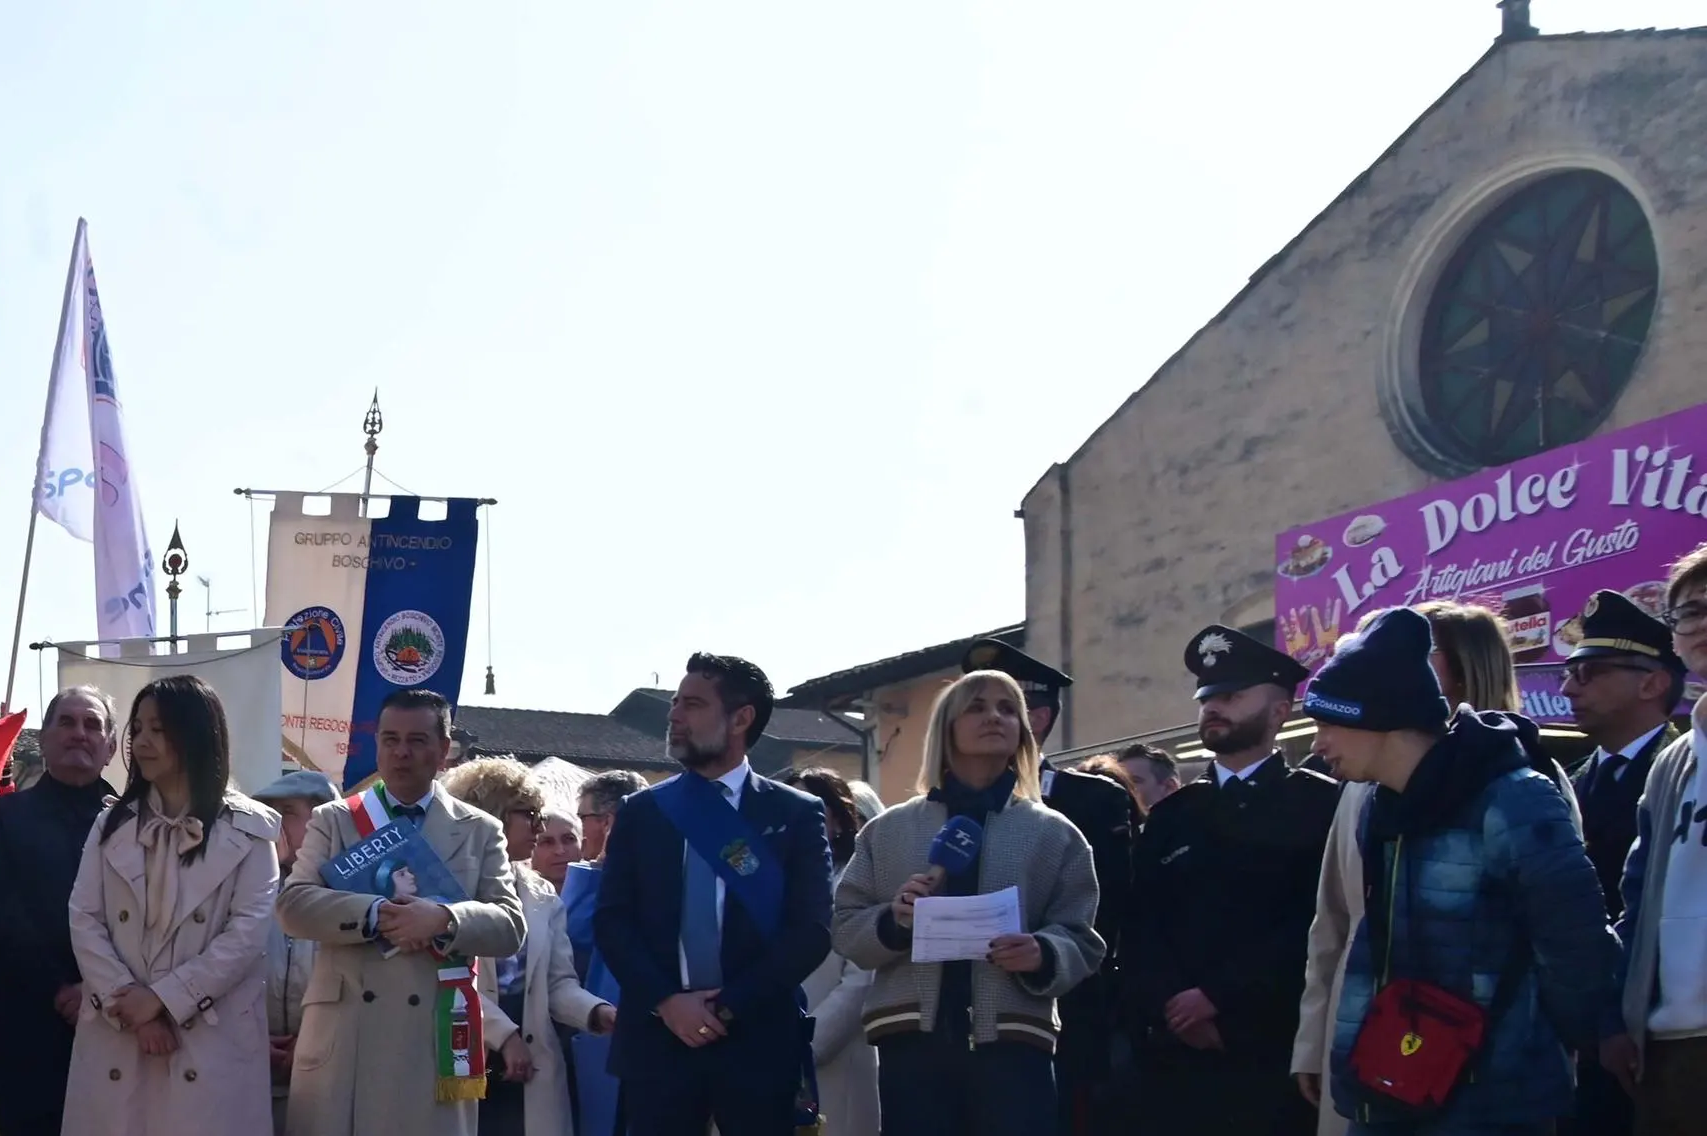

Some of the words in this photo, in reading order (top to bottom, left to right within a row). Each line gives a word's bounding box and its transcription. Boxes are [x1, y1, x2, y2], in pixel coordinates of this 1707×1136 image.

[1331, 546, 1404, 615] La
[1419, 464, 1578, 557] Dolce
[1608, 445, 1707, 519] Vita
[294, 531, 353, 546] GRUPPO
[357, 534, 453, 550] ANTINCENDIO
[332, 554, 406, 571] BOSCHIVO
[1404, 549, 1518, 606] Artigiani
[1518, 541, 1555, 570] del
[1562, 518, 1640, 567] Gusto
[1315, 698, 1361, 716] COMAZOO
[281, 714, 306, 729] ONTE
[334, 826, 403, 875] LIBERTY
